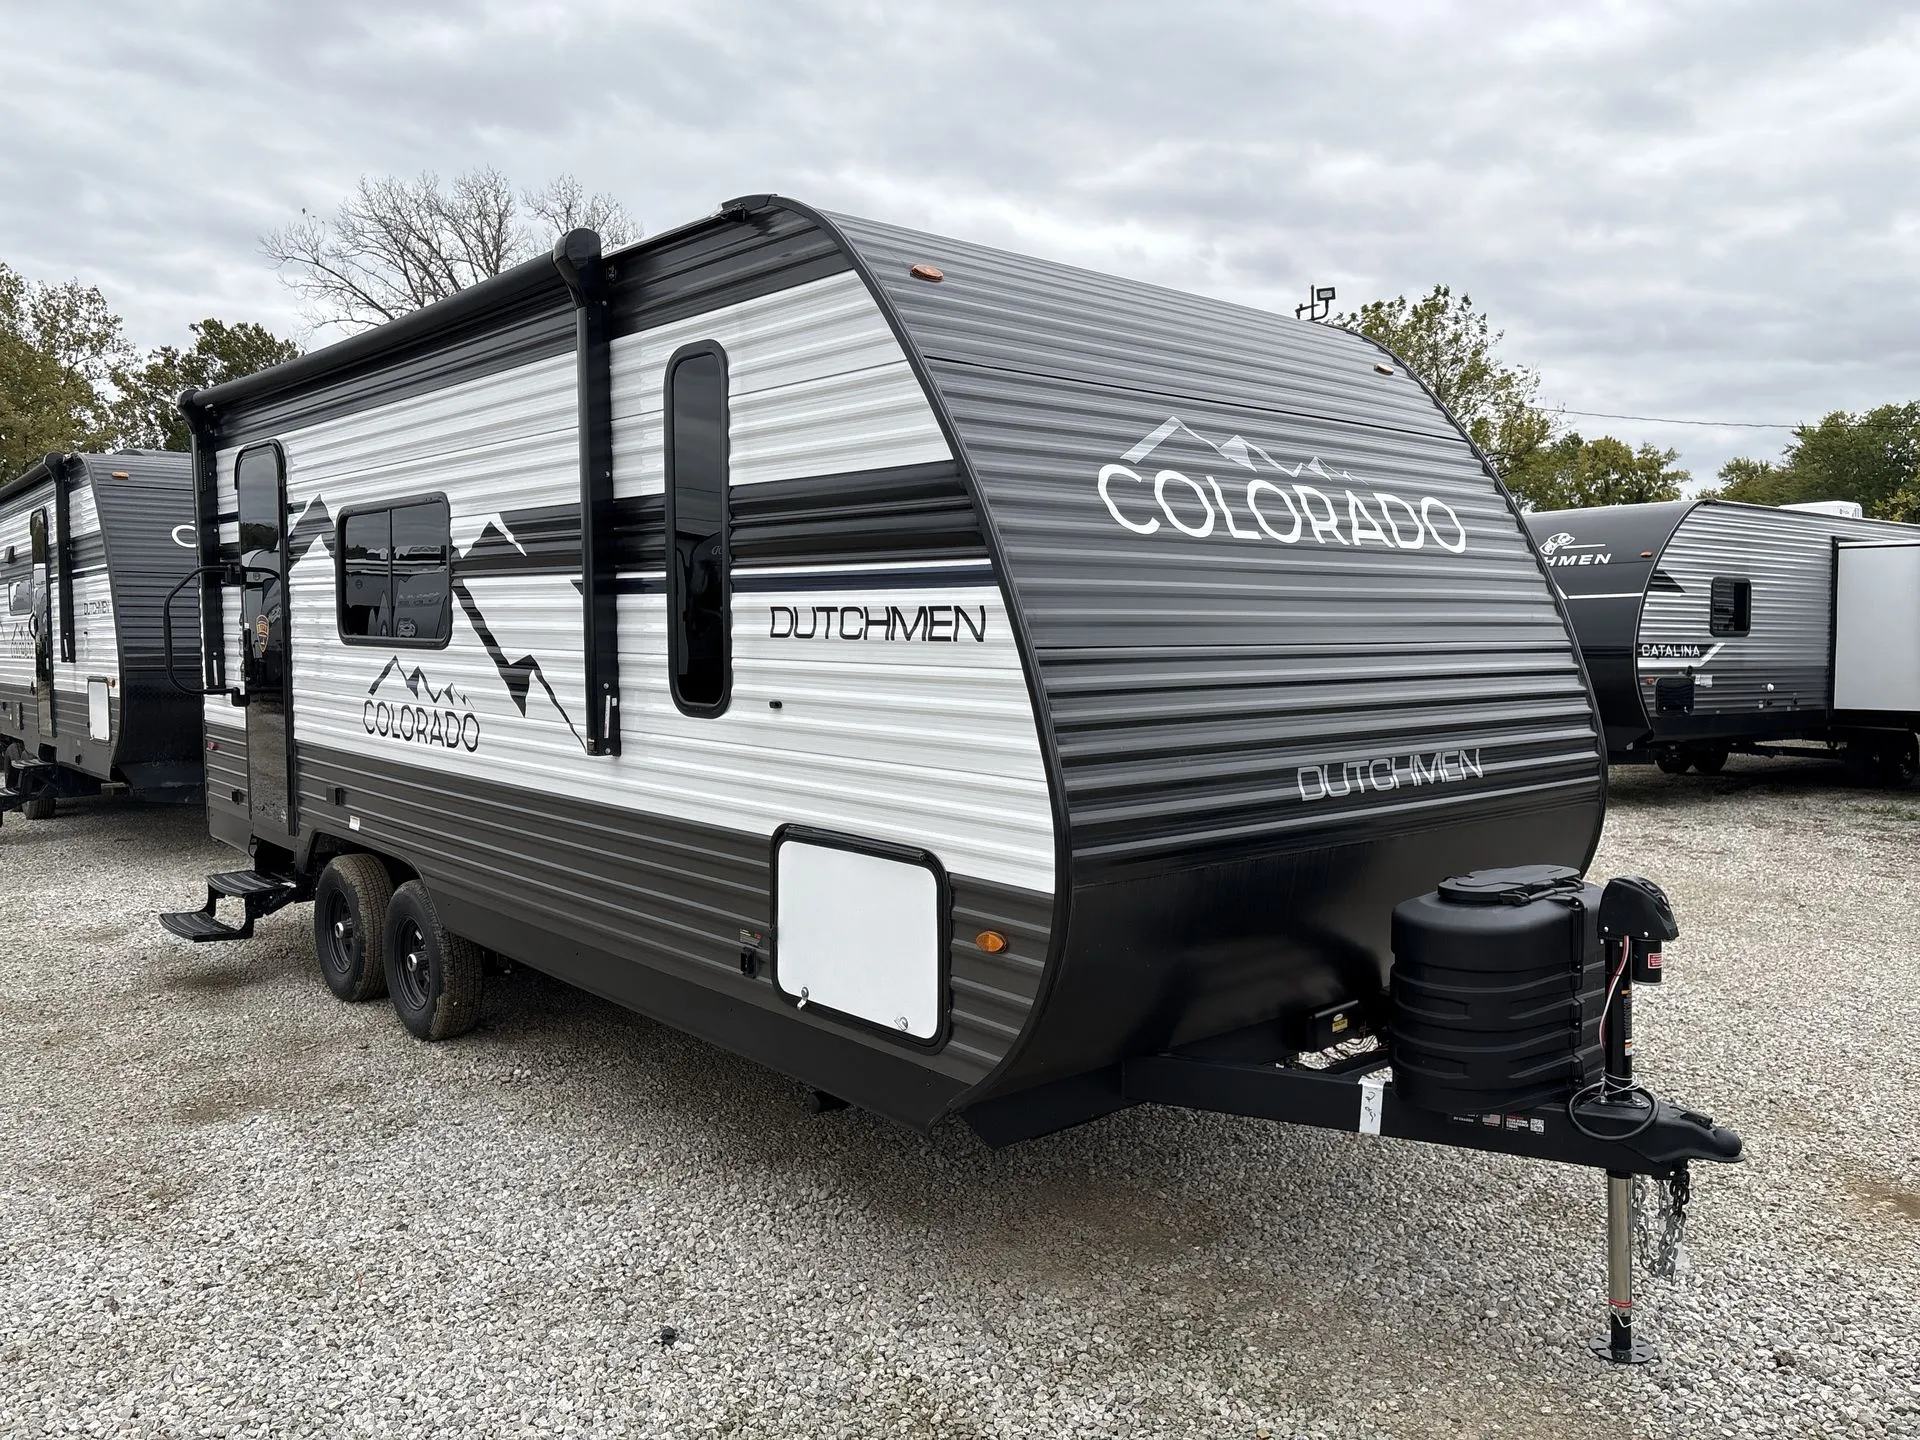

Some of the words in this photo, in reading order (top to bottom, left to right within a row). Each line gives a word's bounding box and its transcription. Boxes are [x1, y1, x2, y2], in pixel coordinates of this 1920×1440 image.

[1098, 463, 1466, 553] COLORADO
[1543, 553, 1612, 567] HMEN
[770, 605, 985, 643] DUTCHMEN
[1641, 644, 1701, 657] CATALINA
[363, 700, 480, 752] COLORADO
[1297, 748, 1484, 802] DUTCHMEN
